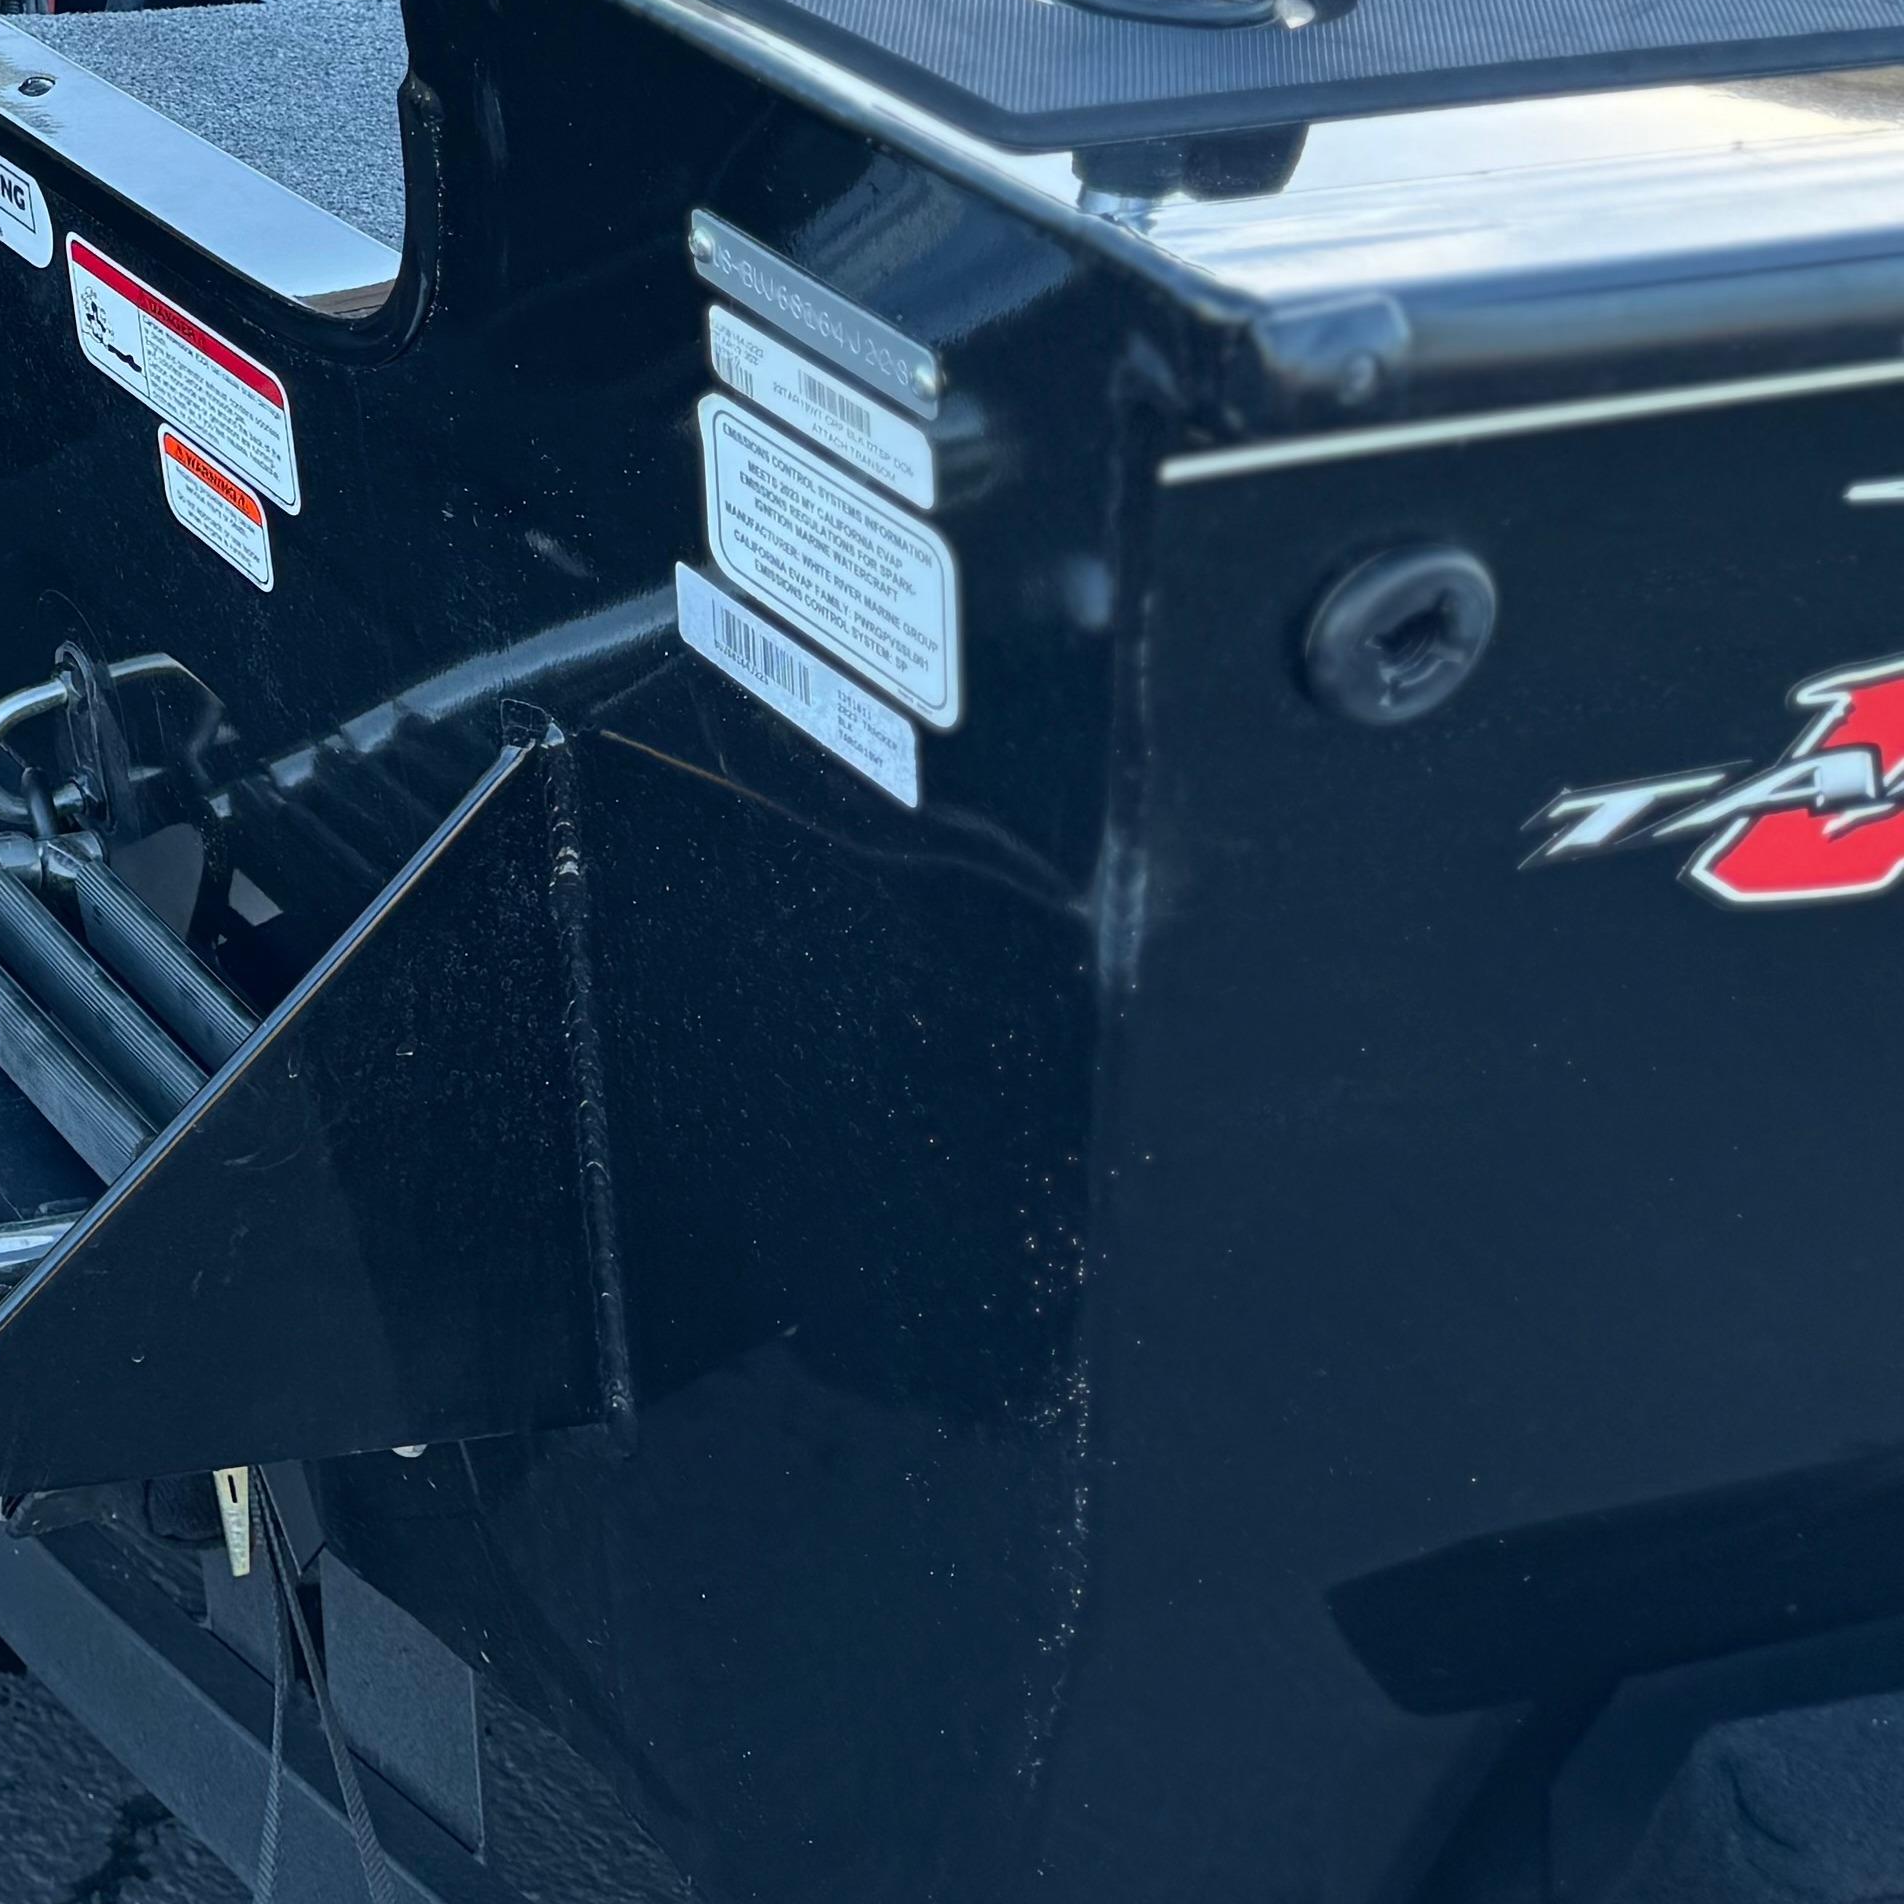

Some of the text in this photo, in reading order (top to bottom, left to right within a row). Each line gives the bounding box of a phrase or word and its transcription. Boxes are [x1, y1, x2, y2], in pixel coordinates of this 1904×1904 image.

[723, 421, 931, 569] EMISSIONS CONTROL SYSTEMS INFORMATION
[740, 470, 786, 512] EMISSIONS
[789, 503, 854, 557] REGULATIONS
[857, 548, 876, 571] FOR
[734, 528, 786, 574] CALIFORNIA
[789, 565, 811, 591] EVAP
[817, 505, 873, 553] CALIFORNIA
[876, 544, 902, 572] EVAP
[833, 548, 897, 603] WATERCRAFT
[755, 559, 801, 601] EMISSIONS
[804, 592, 848, 634] CONTROL
[802, 552, 830, 583] WHITE
[834, 573, 861, 604] RIVER
[864, 594, 899, 630] MARINE
[902, 620, 938, 656] GROUP
